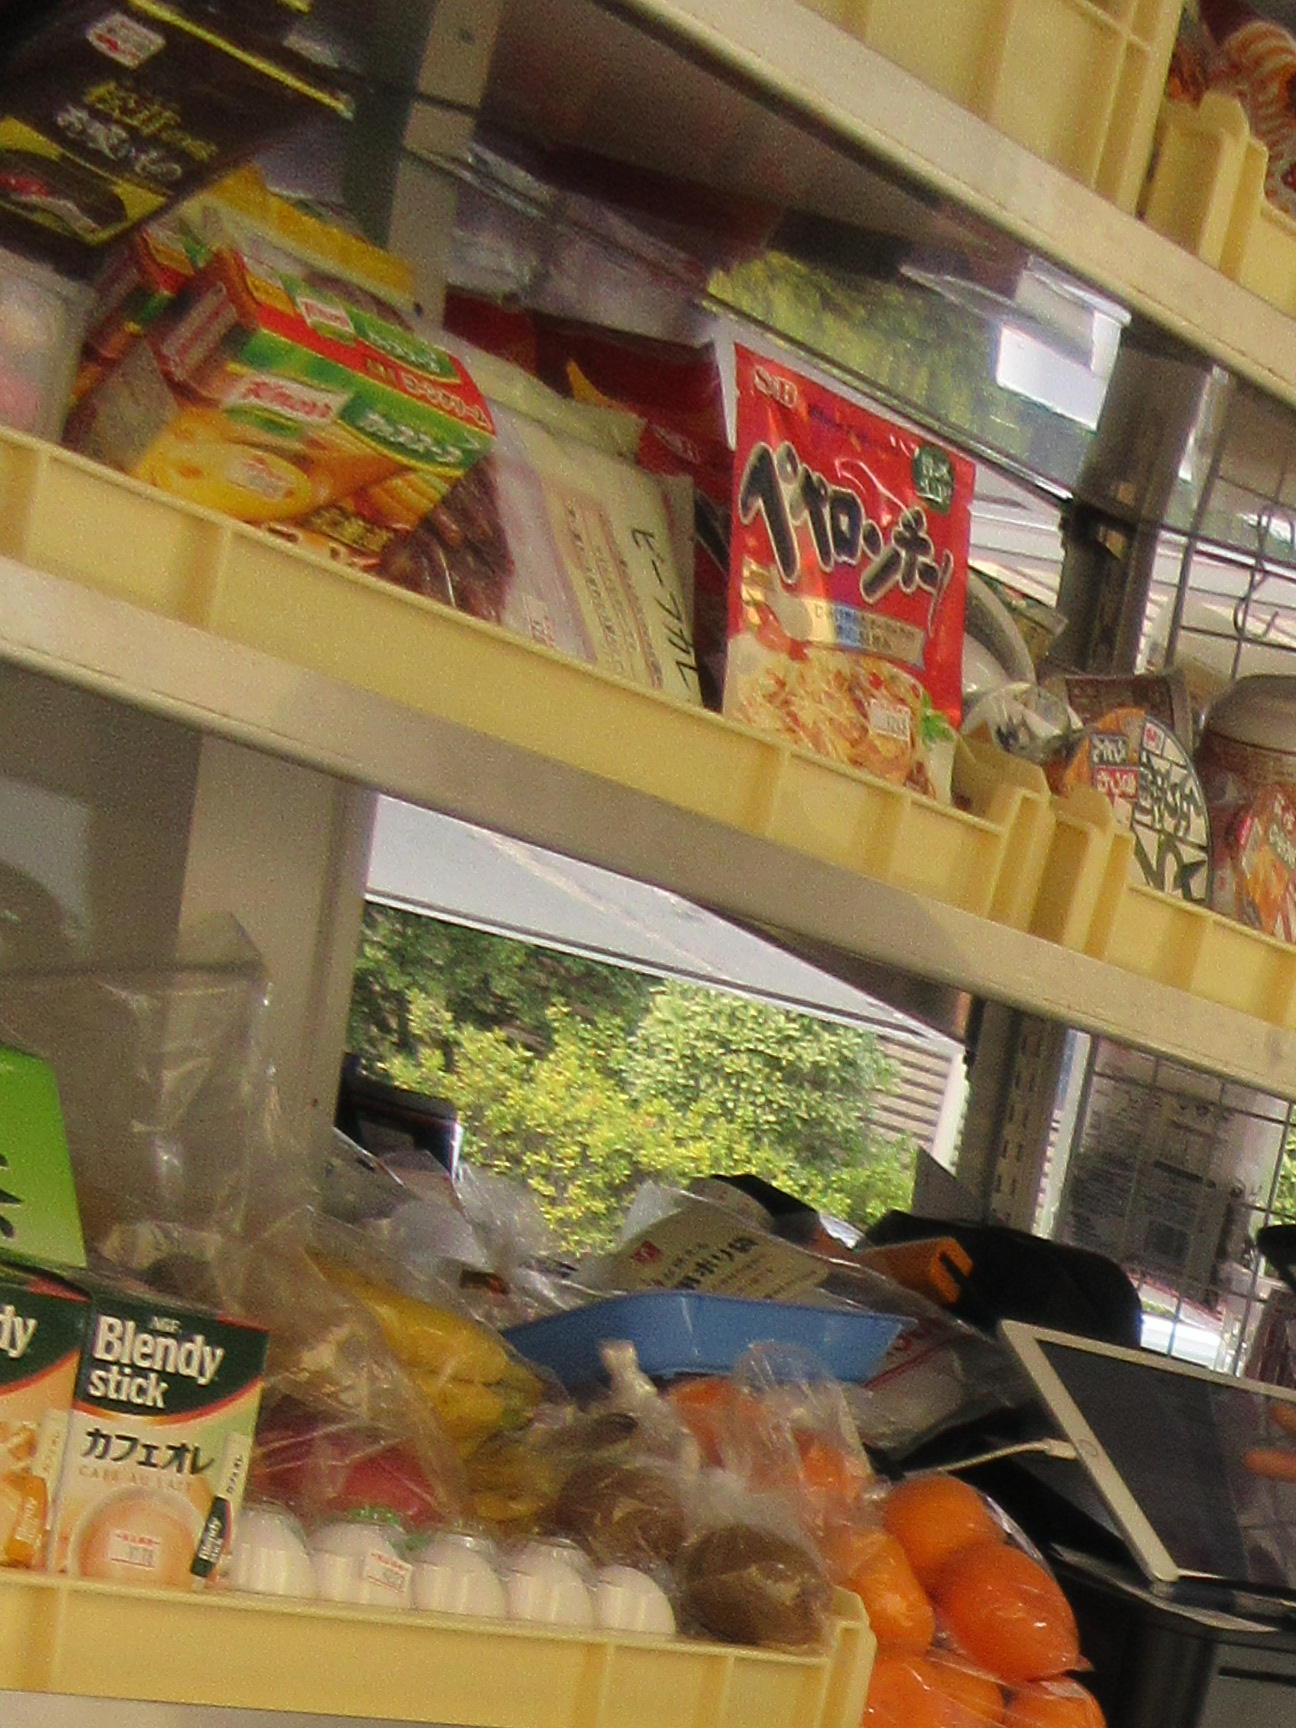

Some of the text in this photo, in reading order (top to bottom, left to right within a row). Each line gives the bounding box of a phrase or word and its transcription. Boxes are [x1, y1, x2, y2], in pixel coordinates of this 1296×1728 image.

[631, 526, 701, 693] ビーフカレ
[92, 1313, 225, 1386] Blendy
[87, 1366, 170, 1410] stick
[79, 1427, 216, 1475] カフェオレ
